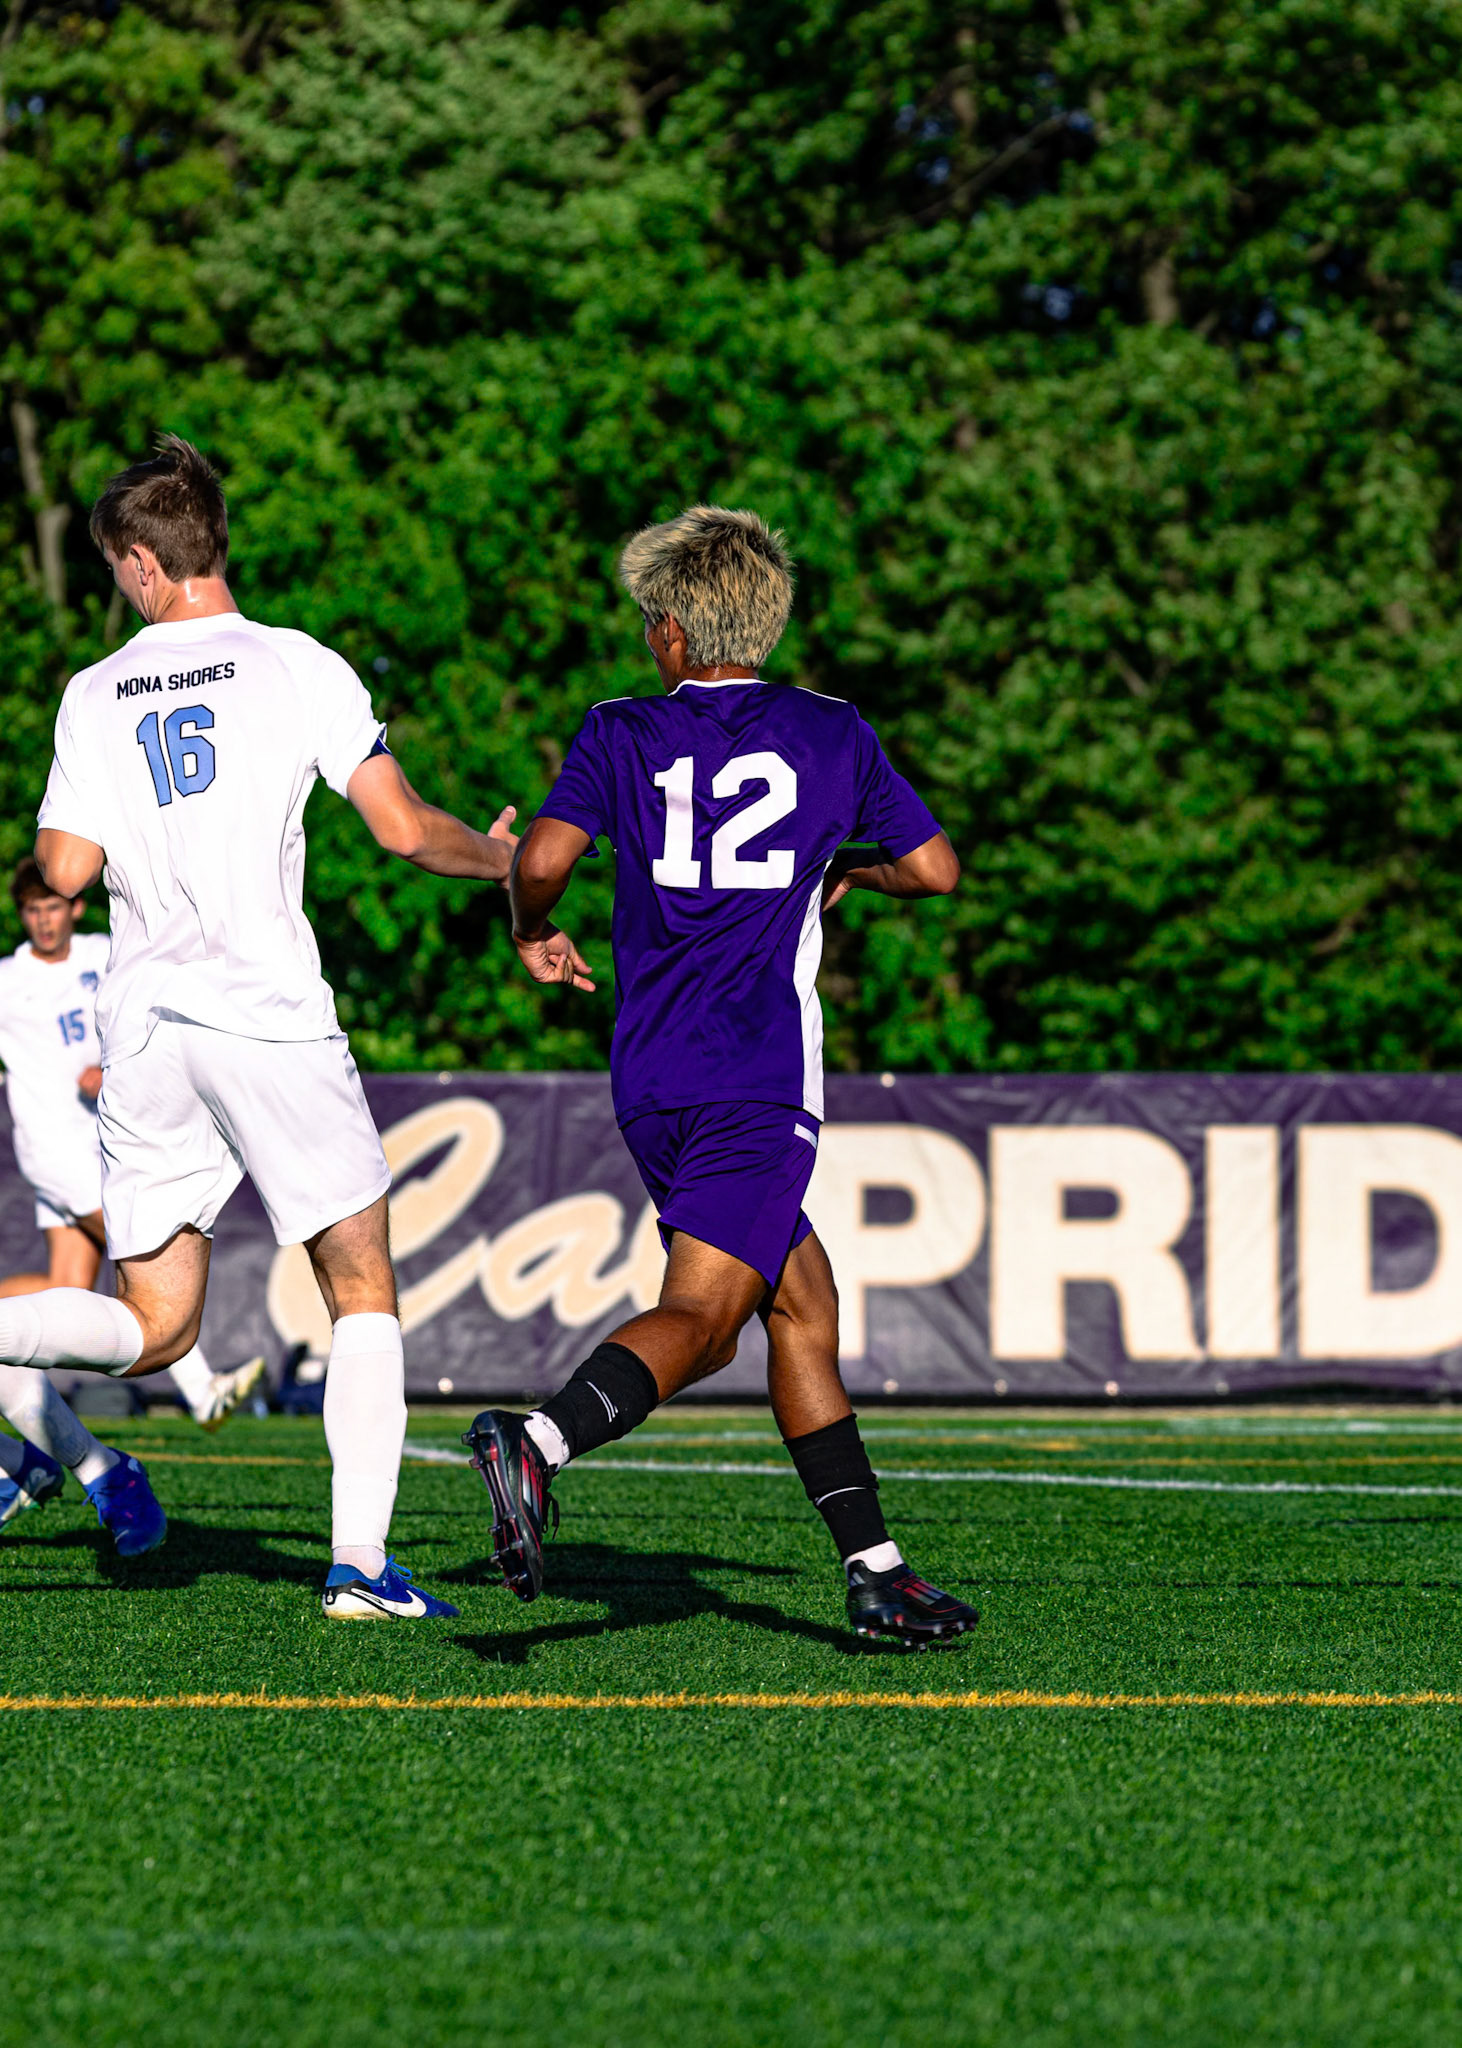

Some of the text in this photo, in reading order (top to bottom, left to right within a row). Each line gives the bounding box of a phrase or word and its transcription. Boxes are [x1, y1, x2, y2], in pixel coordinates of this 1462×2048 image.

[117, 661, 236, 700] MONA SHORES
[136, 704, 216, 808] 16
[652, 751, 798, 889] 12
[58, 1007, 85, 1046] 15
